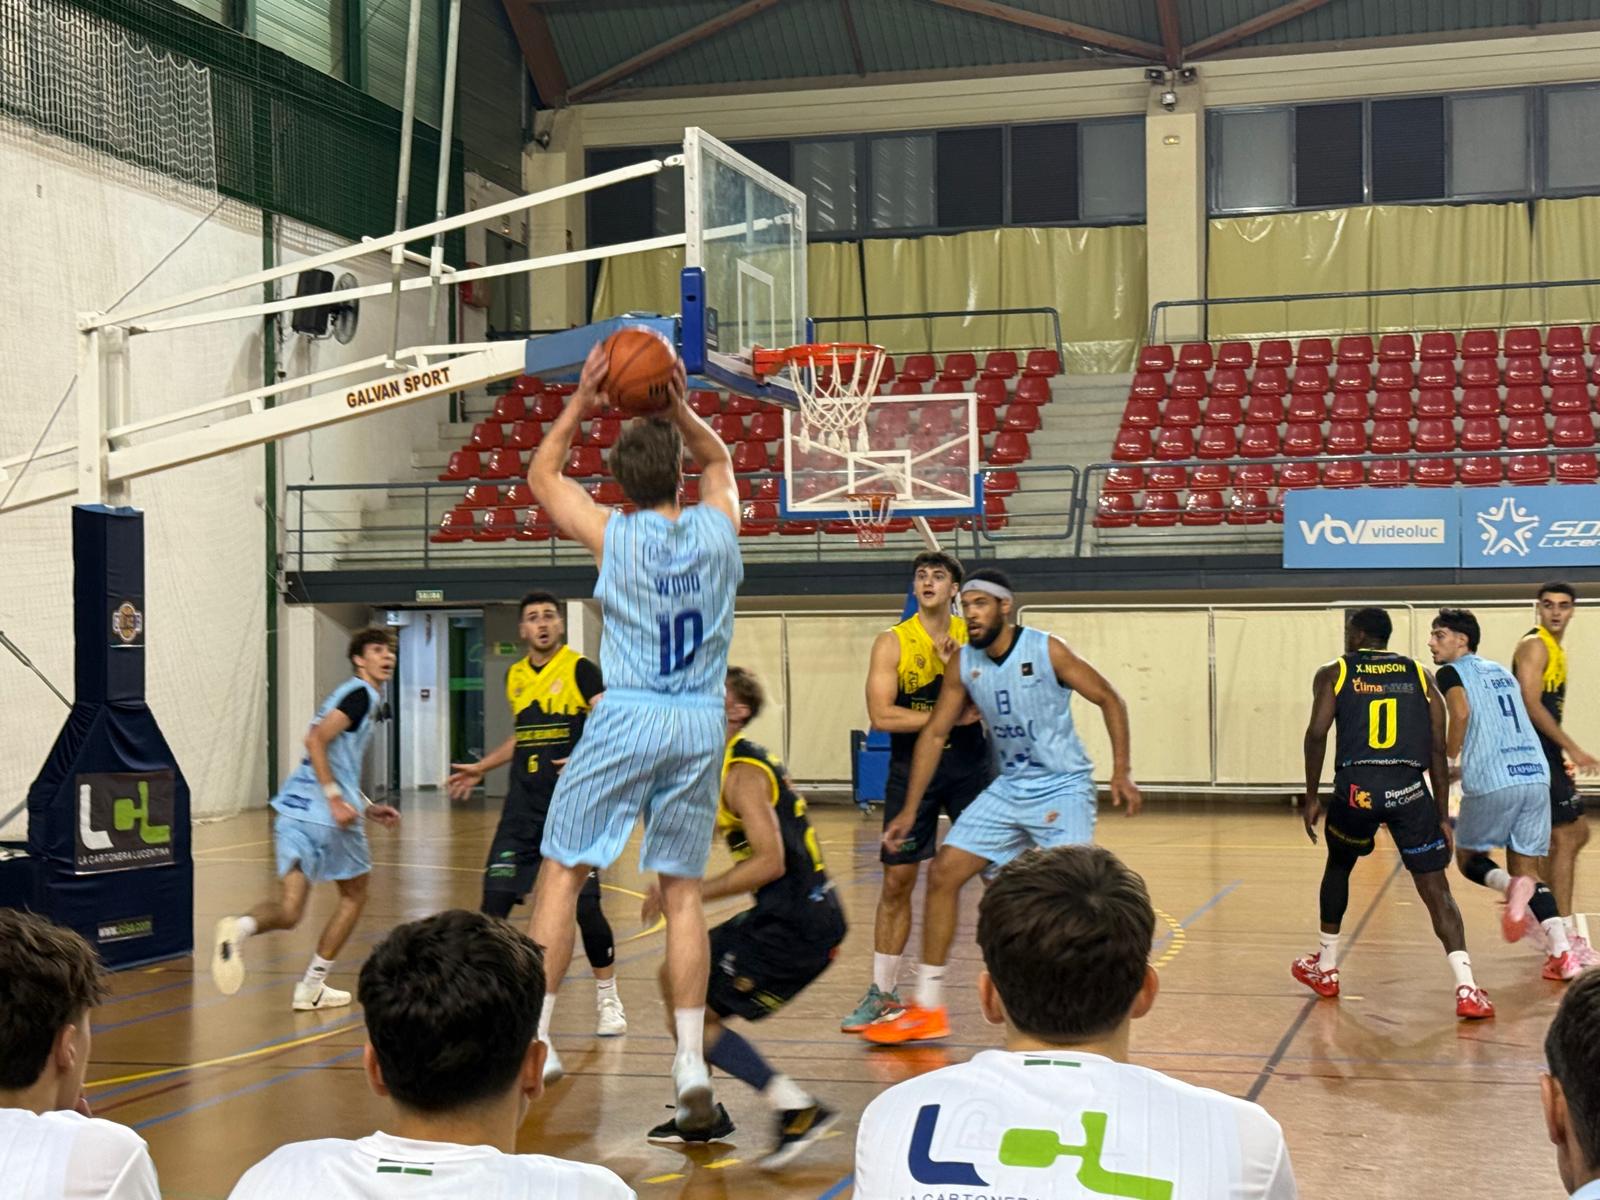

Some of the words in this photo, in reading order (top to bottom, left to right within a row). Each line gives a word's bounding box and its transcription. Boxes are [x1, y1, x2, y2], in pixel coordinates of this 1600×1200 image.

[346, 380, 401, 408] GALVAN
[404, 366, 450, 393] SPORT
[1372, 525, 1438, 538] videoluc
[1544, 520, 1600, 538] SO
[654, 573, 700, 597] WOOD
[656, 609, 704, 676] 10
[1369, 698, 1397, 749] 0
[1497, 694, 1521, 734] 4
[527, 754, 539, 773] 6
[1385, 799, 1397, 808] de
